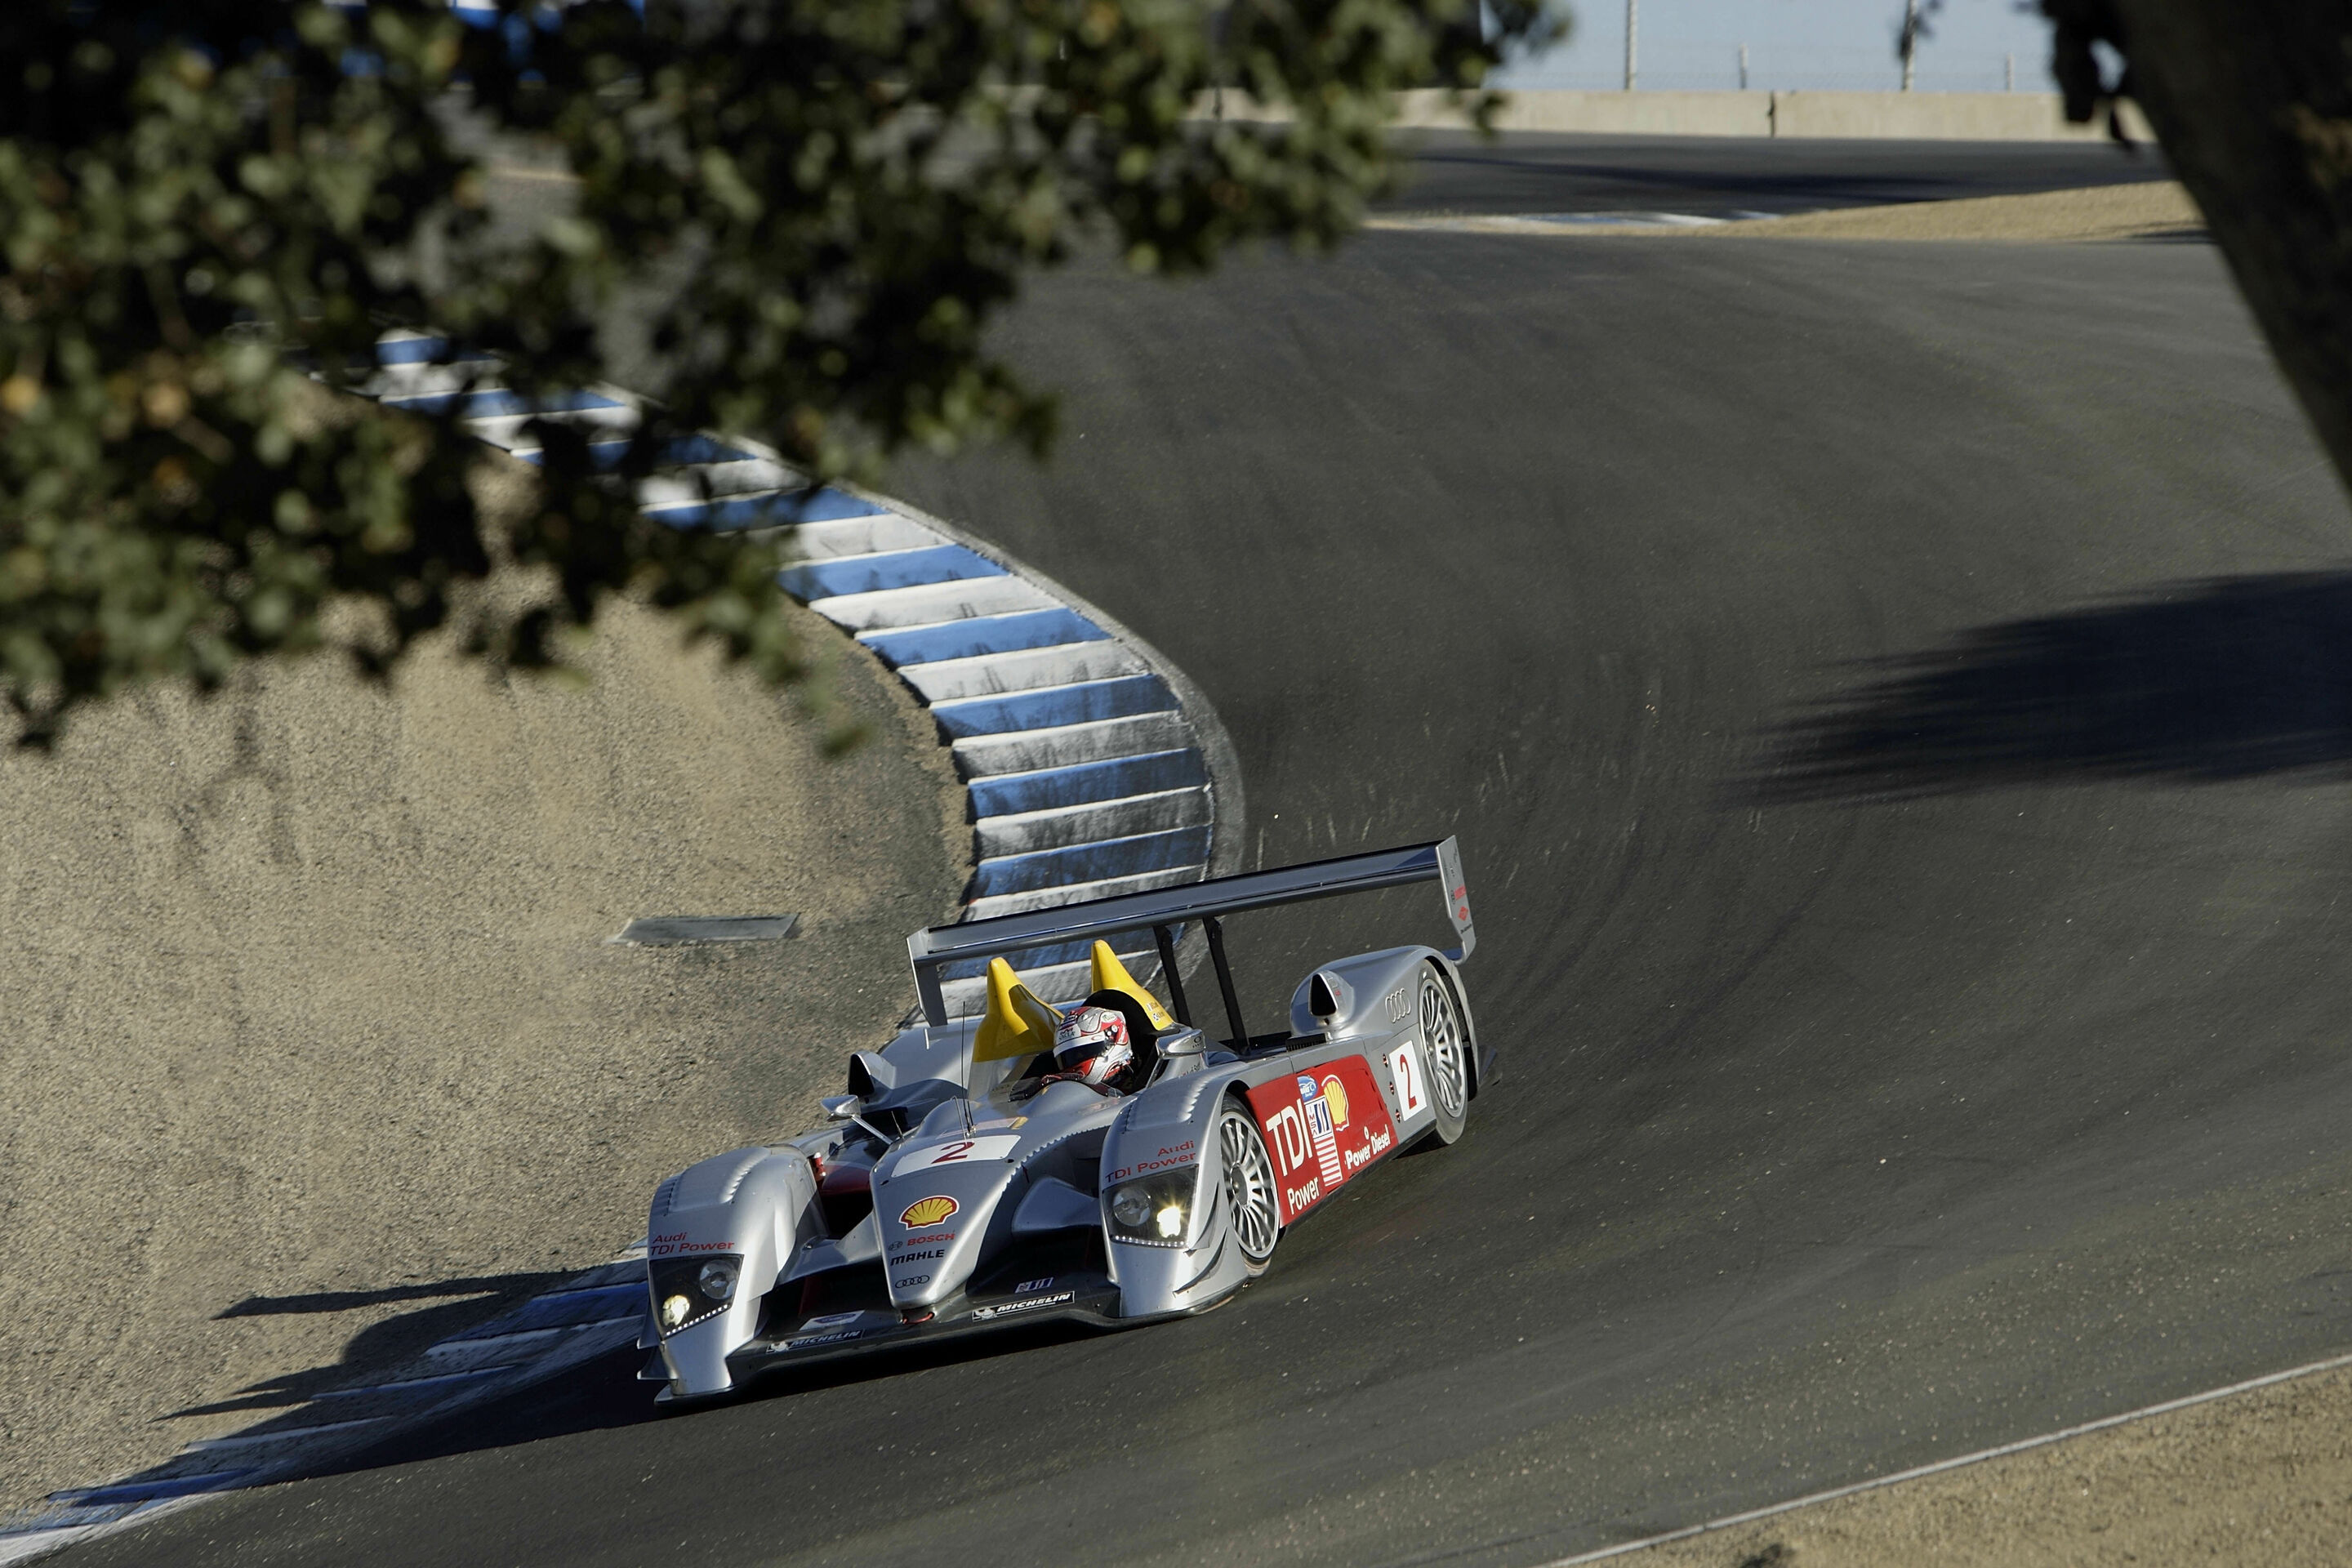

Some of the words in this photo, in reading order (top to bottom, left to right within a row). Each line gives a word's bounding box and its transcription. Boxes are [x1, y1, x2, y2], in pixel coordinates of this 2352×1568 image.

[1400, 1054, 1418, 1111] 2
[1266, 1098, 1313, 1177] TDI
[1370, 1124, 1391, 1156] Diesel
[931, 1141, 975, 1165] 2
[1157, 1140, 1195, 1156] Audi
[1105, 1166, 1132, 1183] TDI
[1137, 1152, 1196, 1173] Power
[1287, 1176, 1320, 1216] Power
[653, 1232, 688, 1244] Audi
[907, 1233, 956, 1246] BOSCH
[650, 1244, 675, 1256] TDI
[679, 1241, 735, 1253] Power
[890, 1249, 945, 1267] MAHLE
[996, 1293, 1071, 1312] MICHELIN
[789, 1330, 862, 1347] MICHELIN
